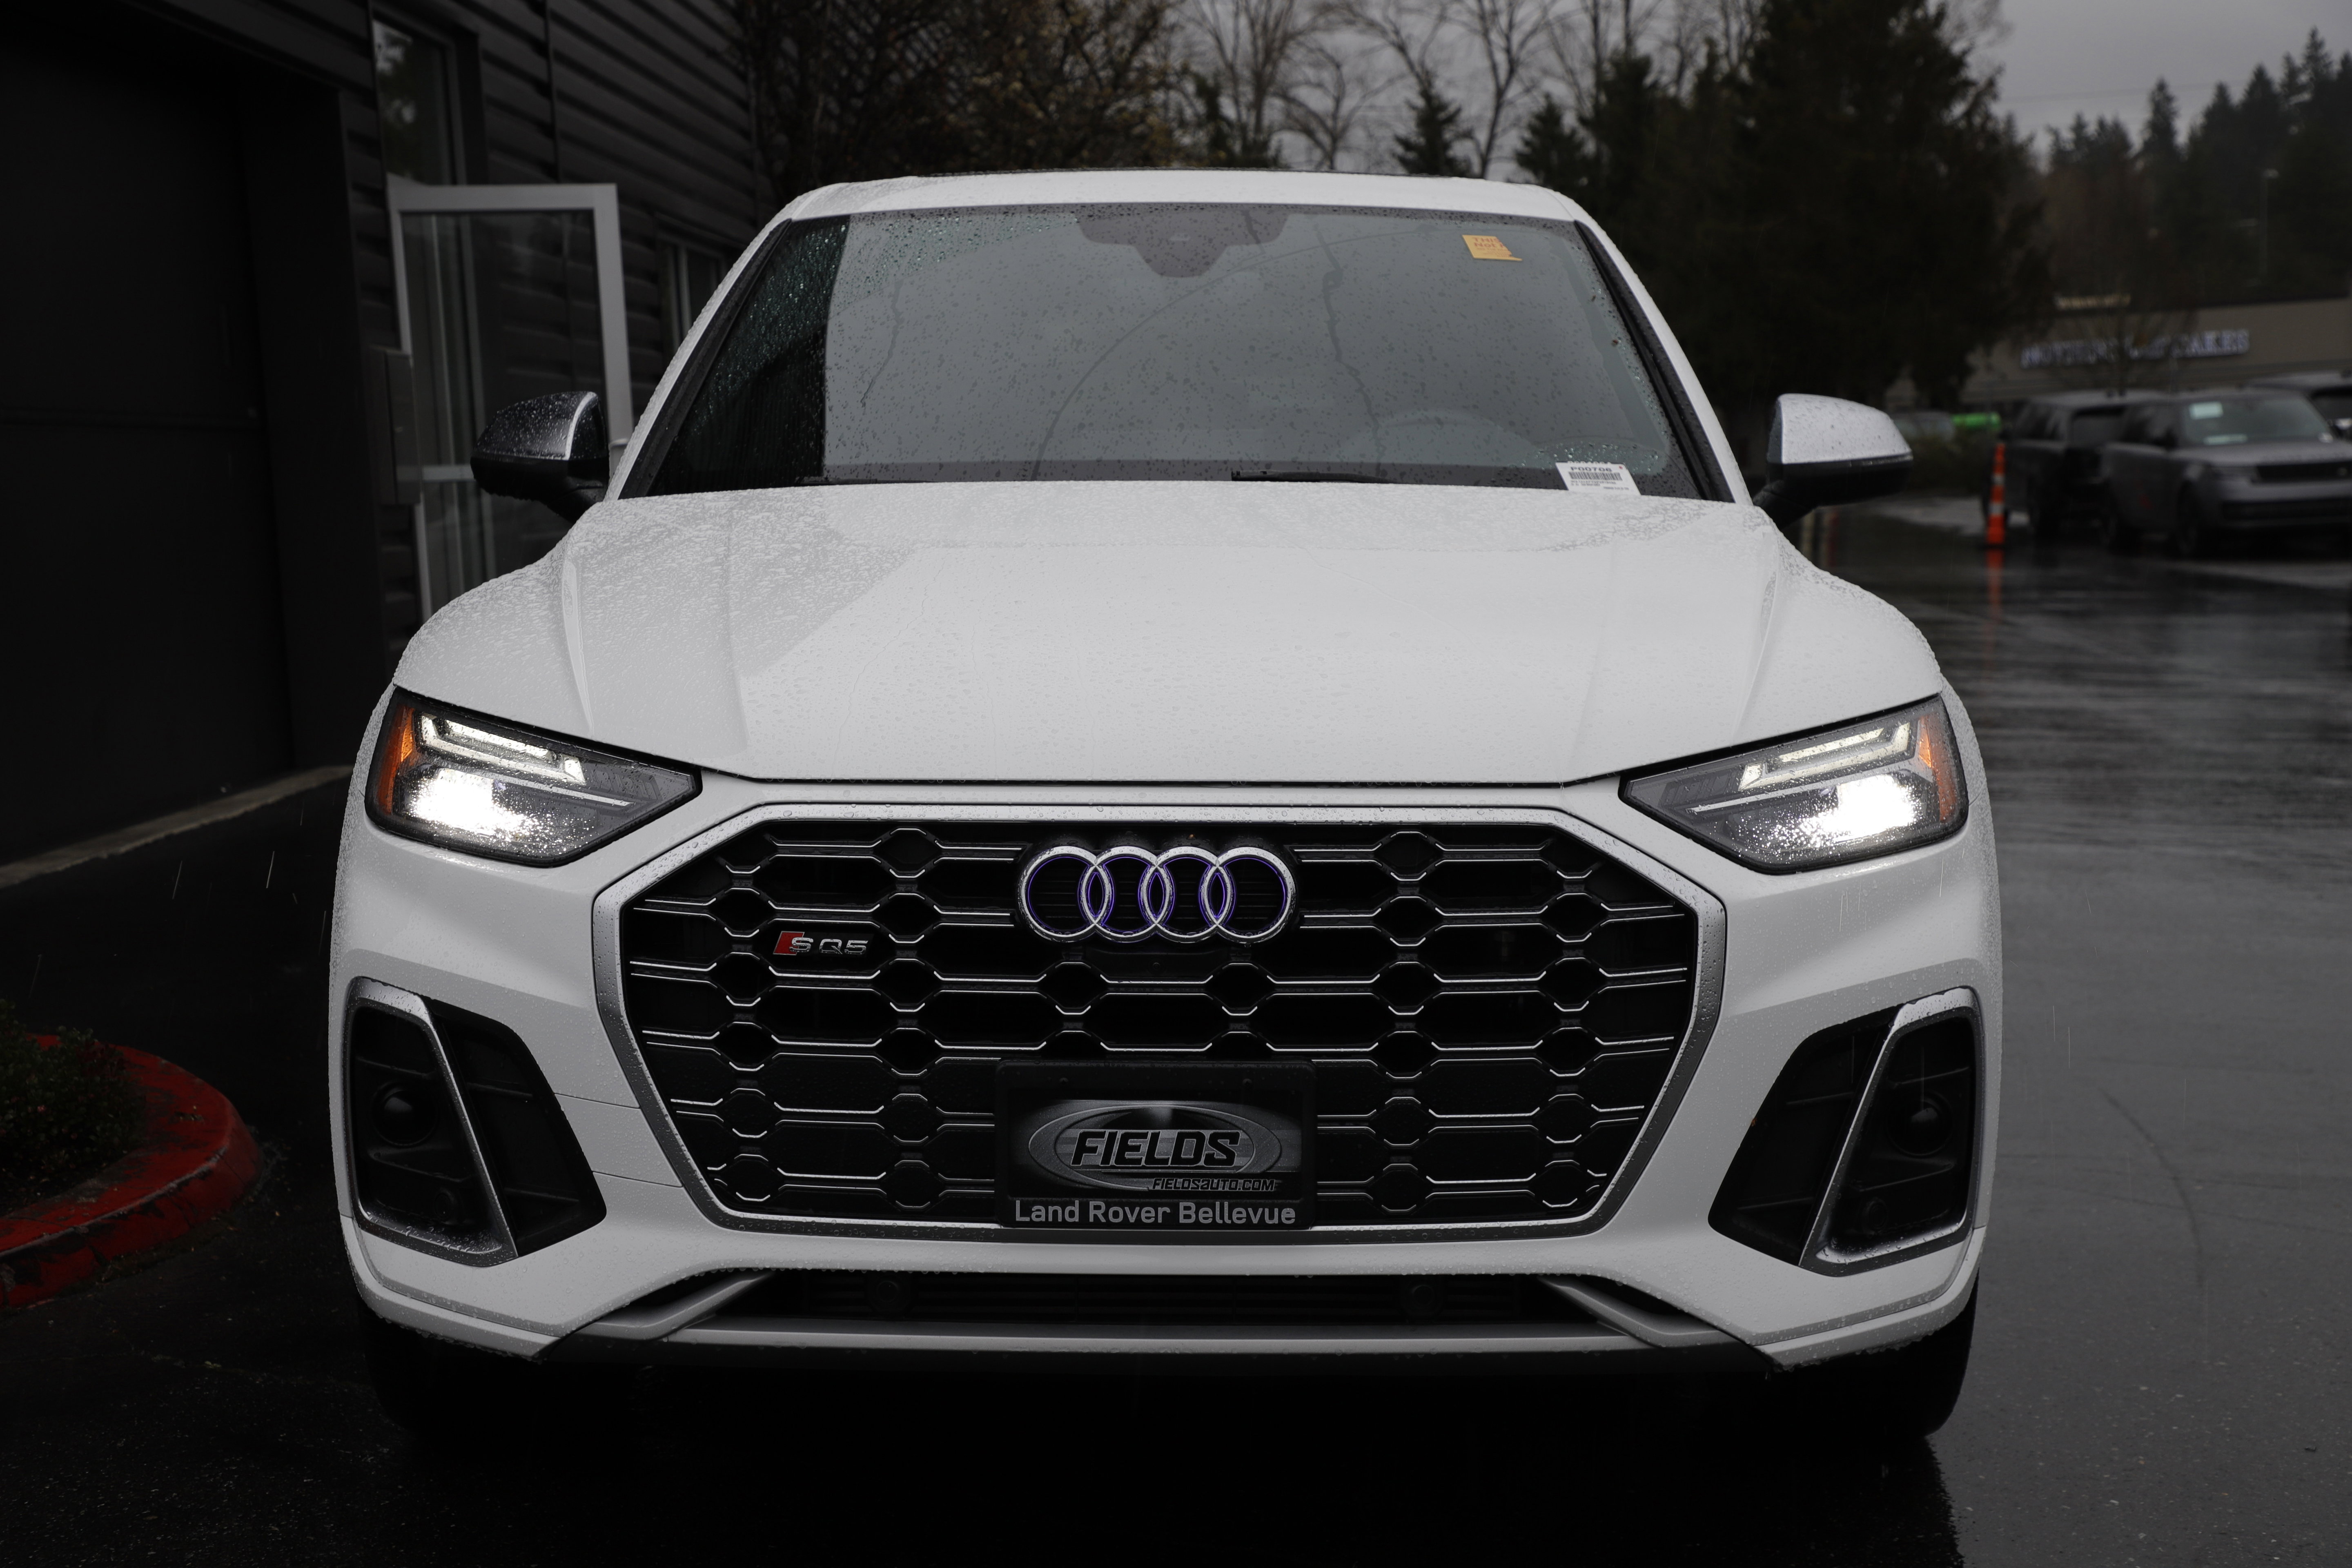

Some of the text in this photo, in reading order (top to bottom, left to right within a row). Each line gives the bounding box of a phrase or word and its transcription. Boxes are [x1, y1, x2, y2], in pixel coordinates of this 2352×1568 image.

[1071, 1130, 1241, 1167] FIELDS
[1016, 1200, 1296, 1224] Land Rover Bellevue
